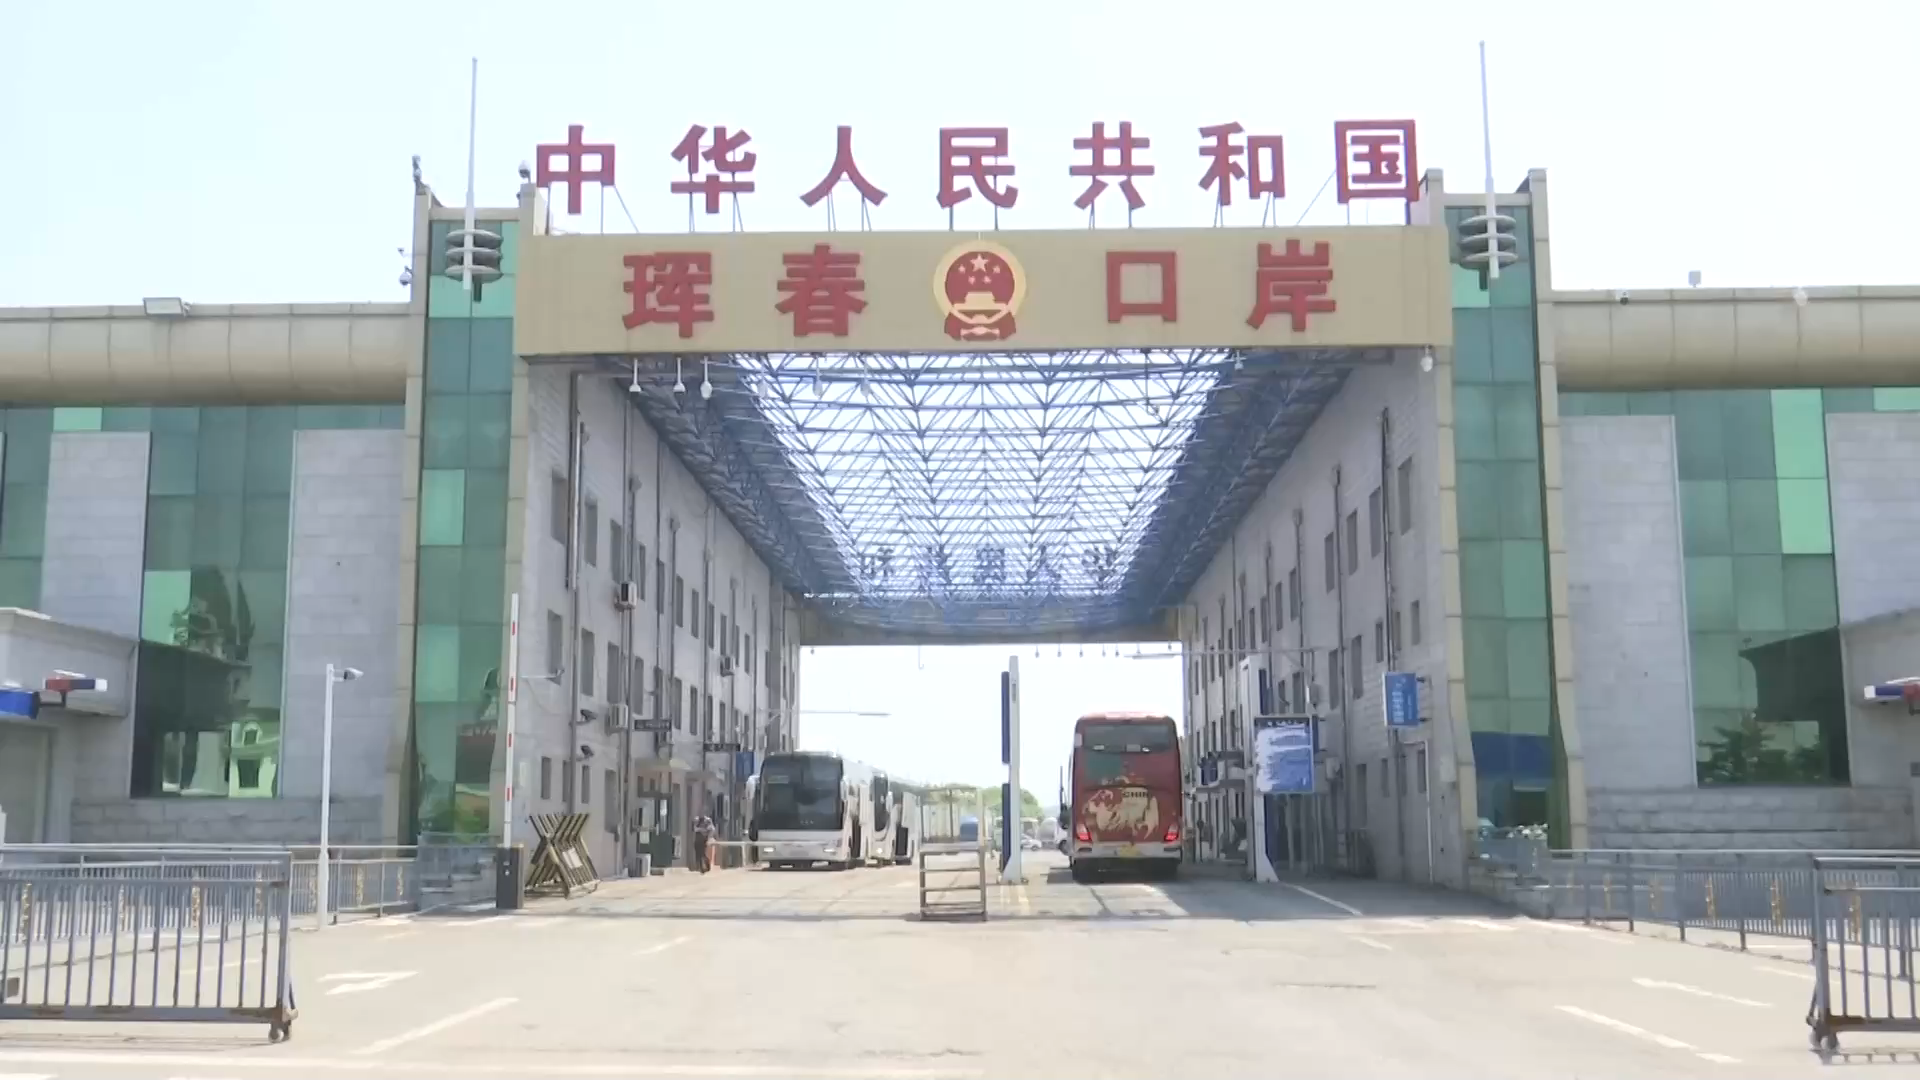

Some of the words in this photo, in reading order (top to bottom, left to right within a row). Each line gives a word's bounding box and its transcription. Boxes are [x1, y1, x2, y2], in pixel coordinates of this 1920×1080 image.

[536, 119, 1420, 215] 中华人民共和国
